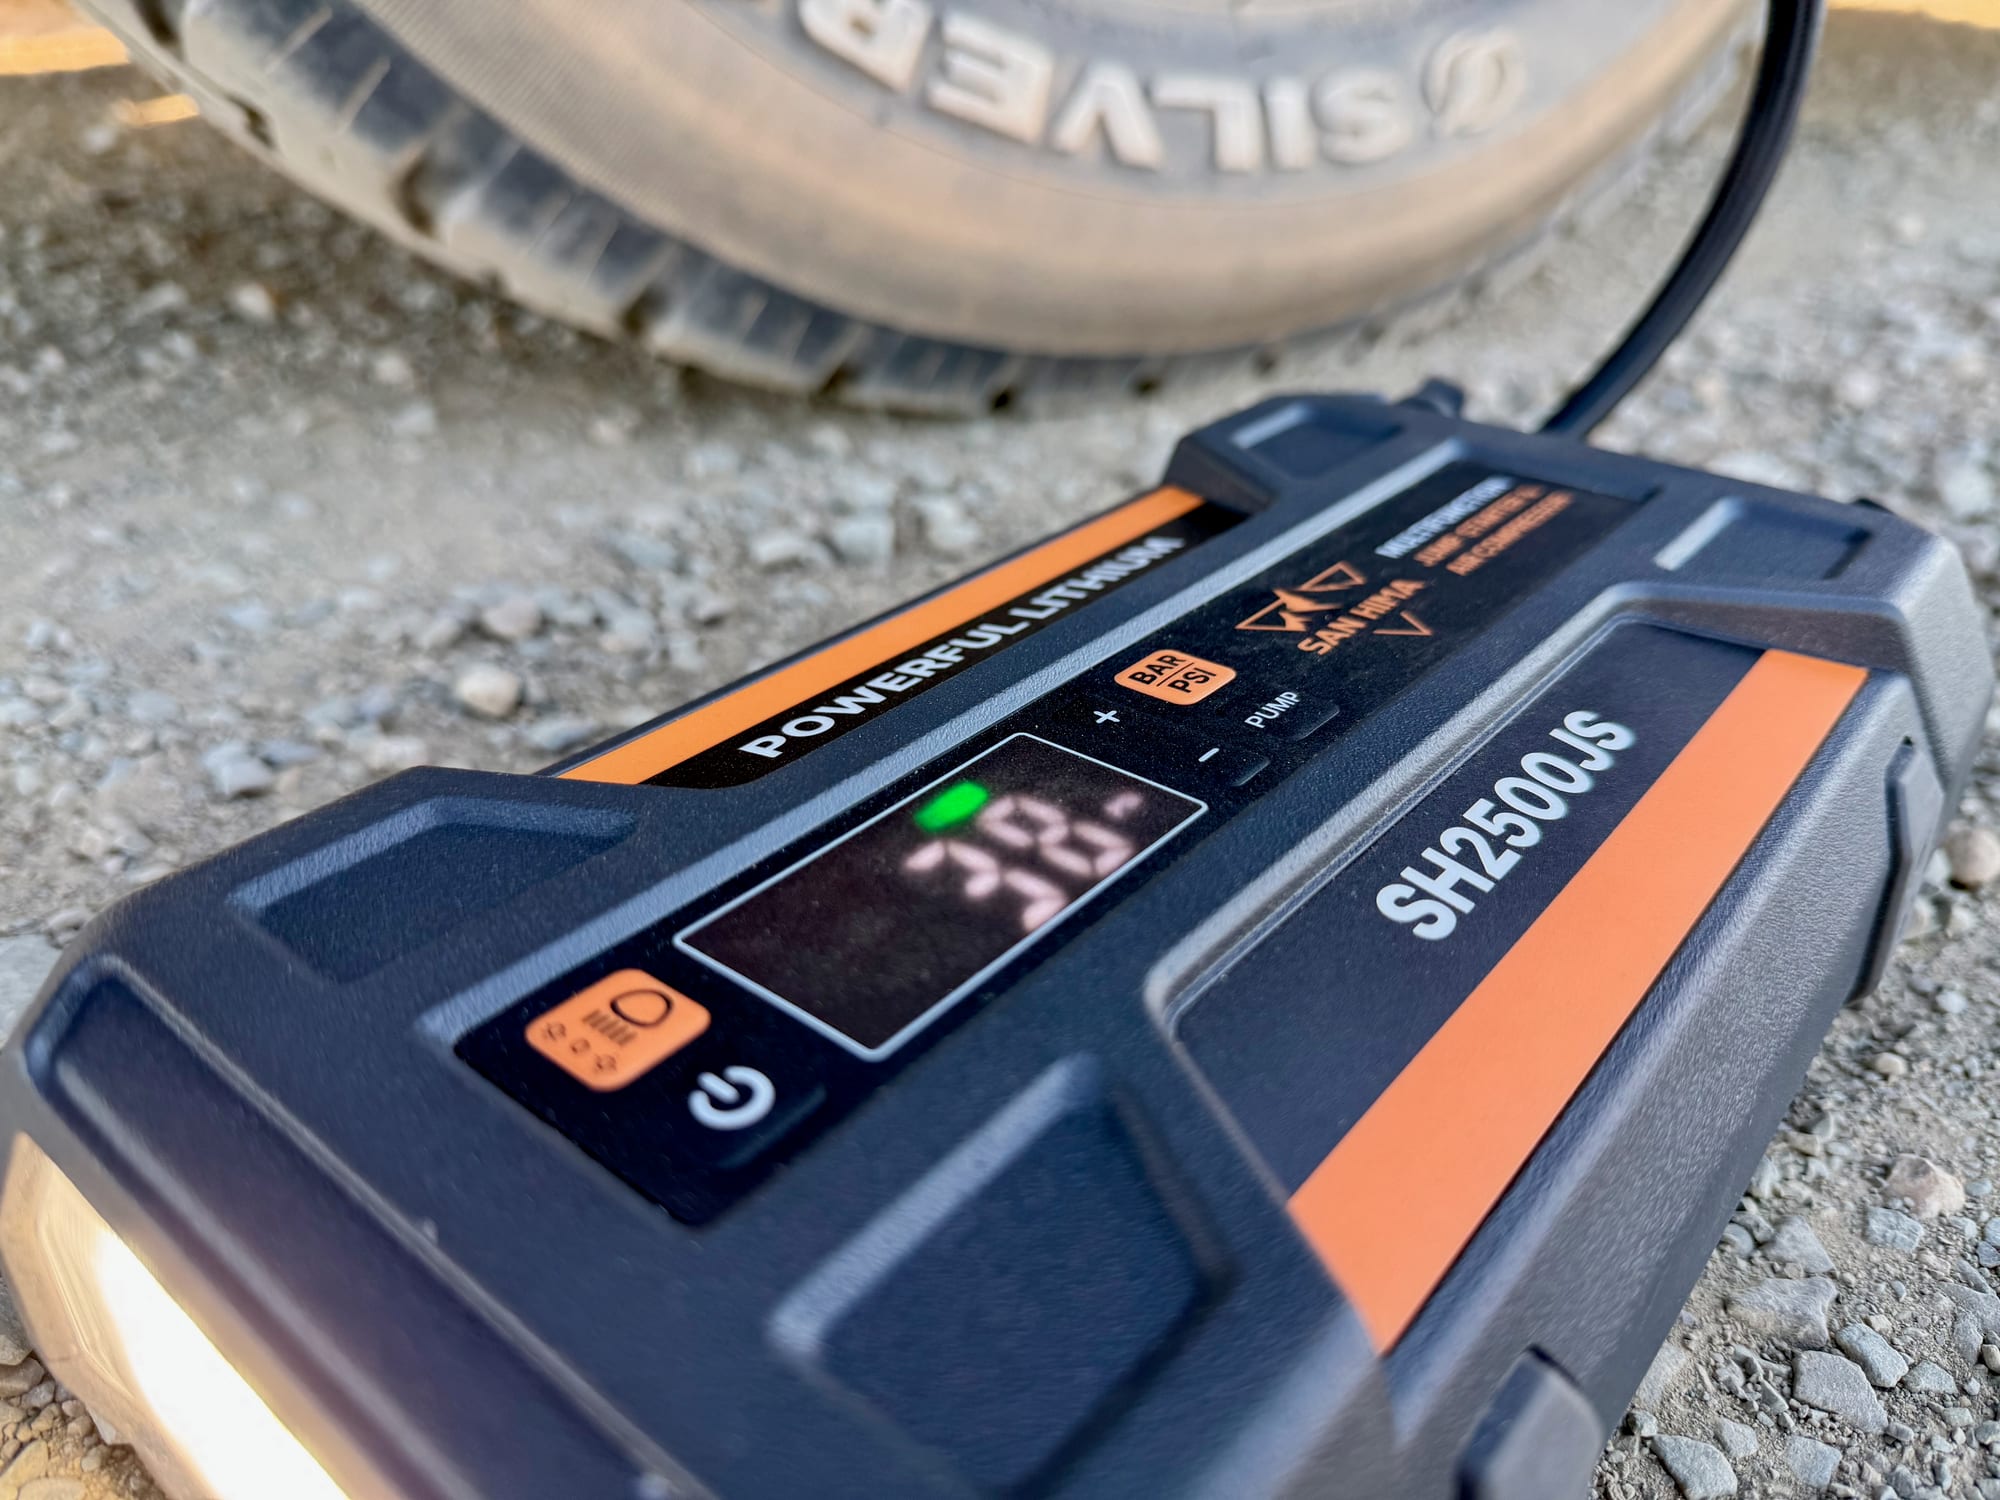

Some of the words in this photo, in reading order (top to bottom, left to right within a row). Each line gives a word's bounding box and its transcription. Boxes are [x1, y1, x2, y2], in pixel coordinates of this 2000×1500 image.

[1297, 616, 1368, 656] SAN
[1349, 579, 1426, 621] HIMA
[738, 617, 1027, 759] POWERFUL
[1009, 536, 1187, 621] LITHIUM
[1128, 654, 1187, 686] BAR
[1168, 667, 1217, 693] PSI
[1244, 691, 1301, 729] PUMP
[1375, 710, 1636, 941] SH2500JS
